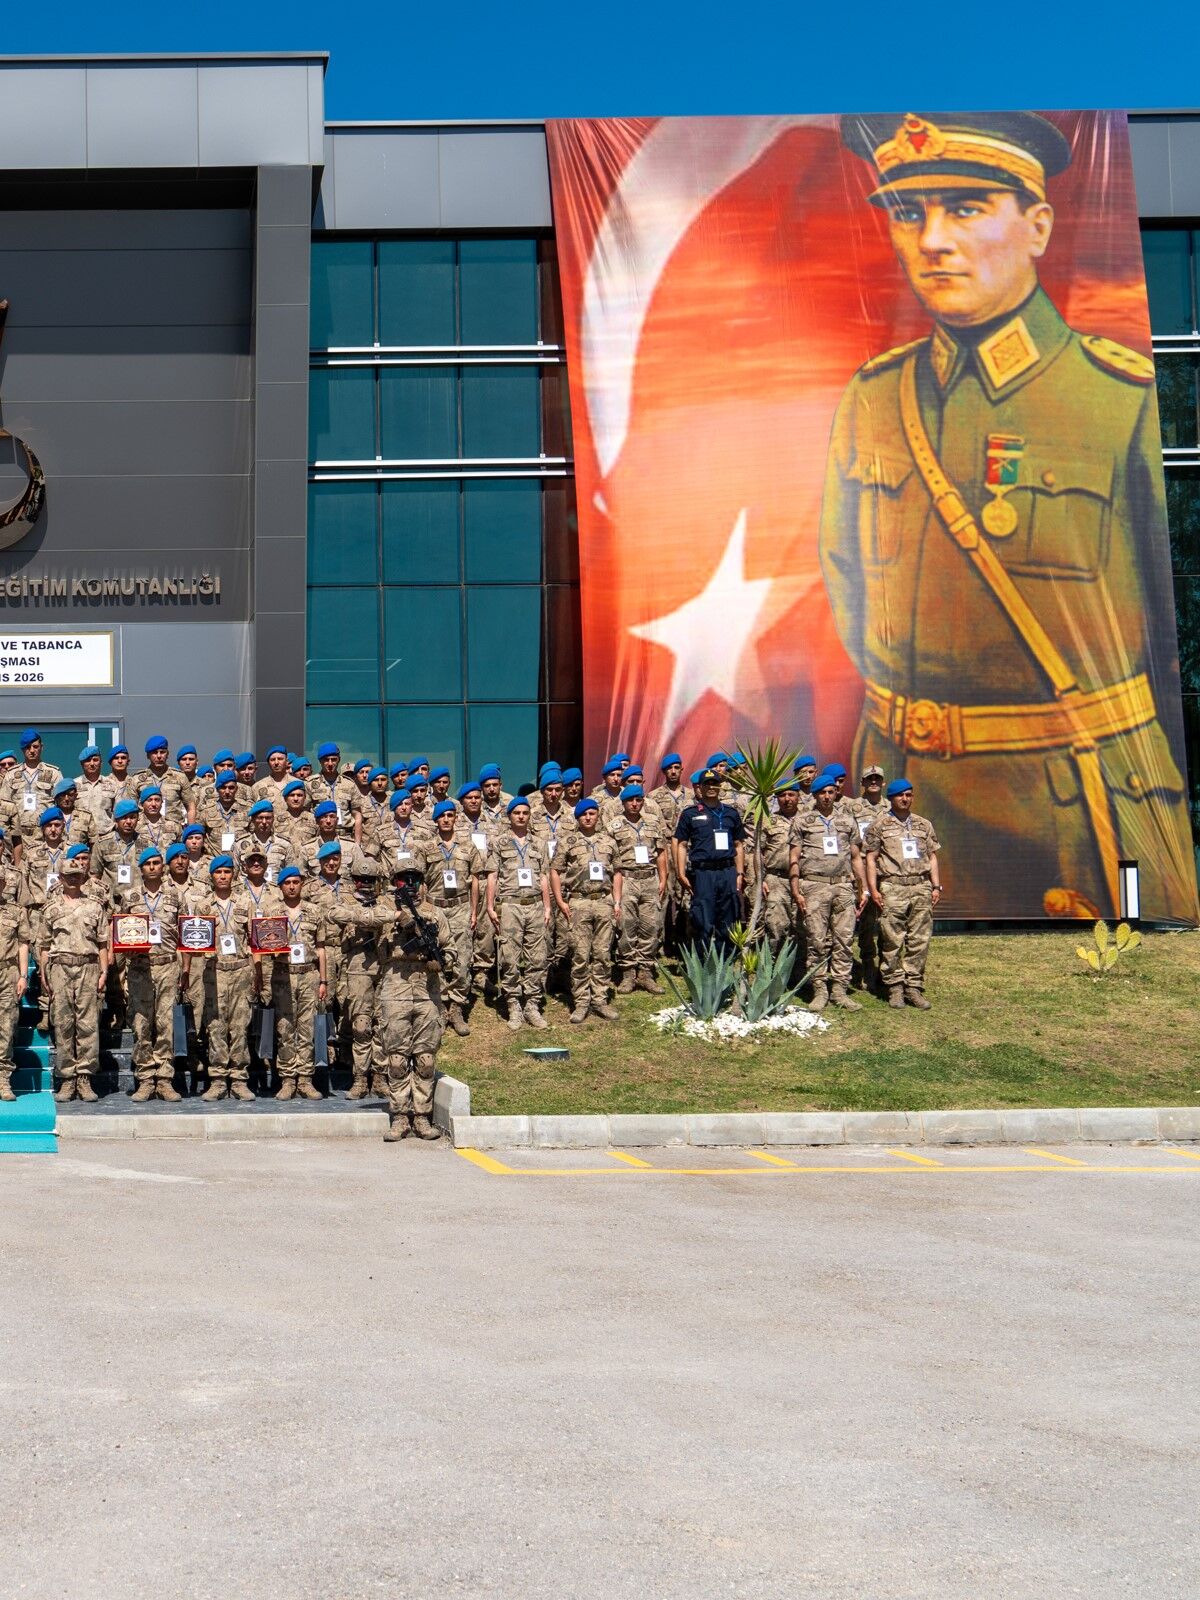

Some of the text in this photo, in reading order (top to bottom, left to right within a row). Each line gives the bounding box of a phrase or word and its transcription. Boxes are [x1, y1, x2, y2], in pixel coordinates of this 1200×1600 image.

[72, 574, 221, 596] KOMUTANLIĞI
[0, 641, 18, 651] VE
[21, 640, 83, 650] TABANCA
[14, 672, 44, 682] 2026
